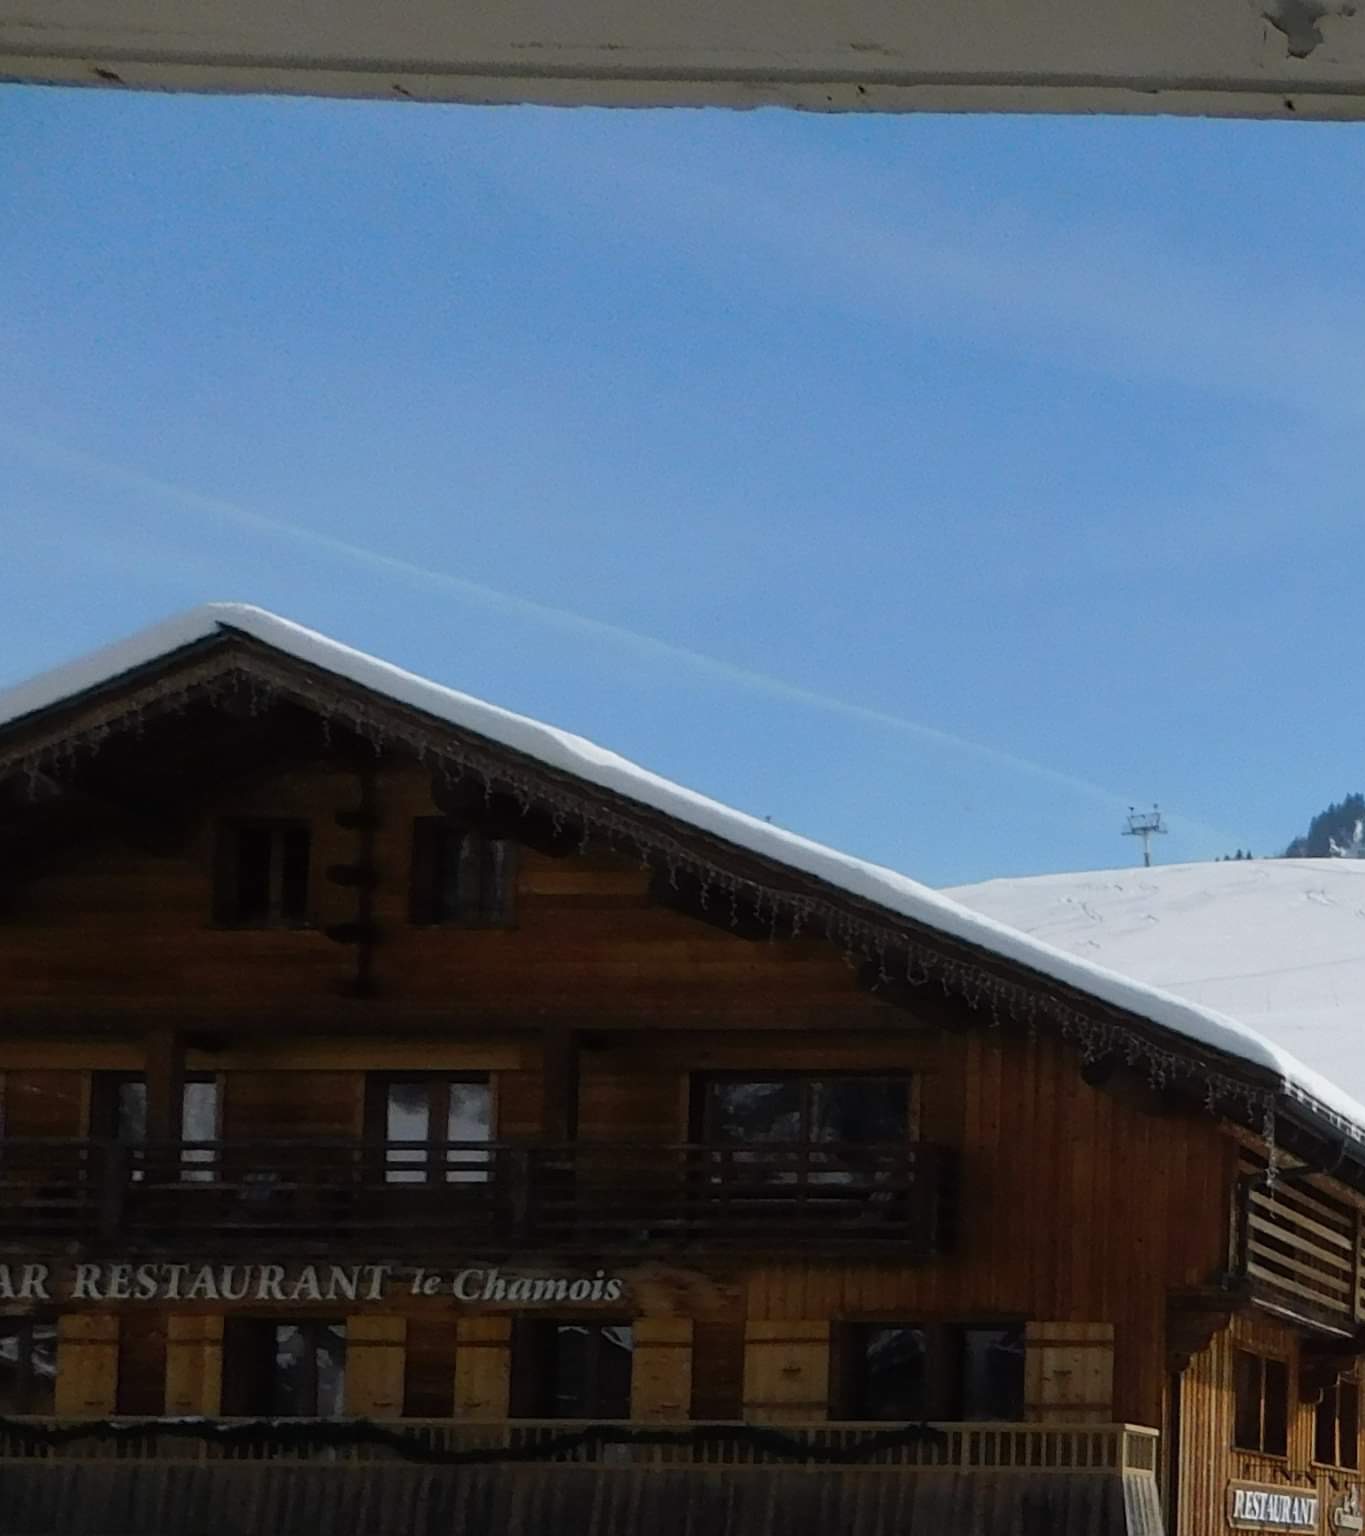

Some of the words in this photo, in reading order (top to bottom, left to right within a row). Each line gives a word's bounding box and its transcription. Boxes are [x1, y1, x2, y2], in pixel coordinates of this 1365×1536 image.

[71, 1263, 393, 1300] RESTAURANT
[411, 1268, 442, 1296] le
[453, 1268, 622, 1301] Chamois
[1233, 1489, 1317, 1525] RESTAURANT
